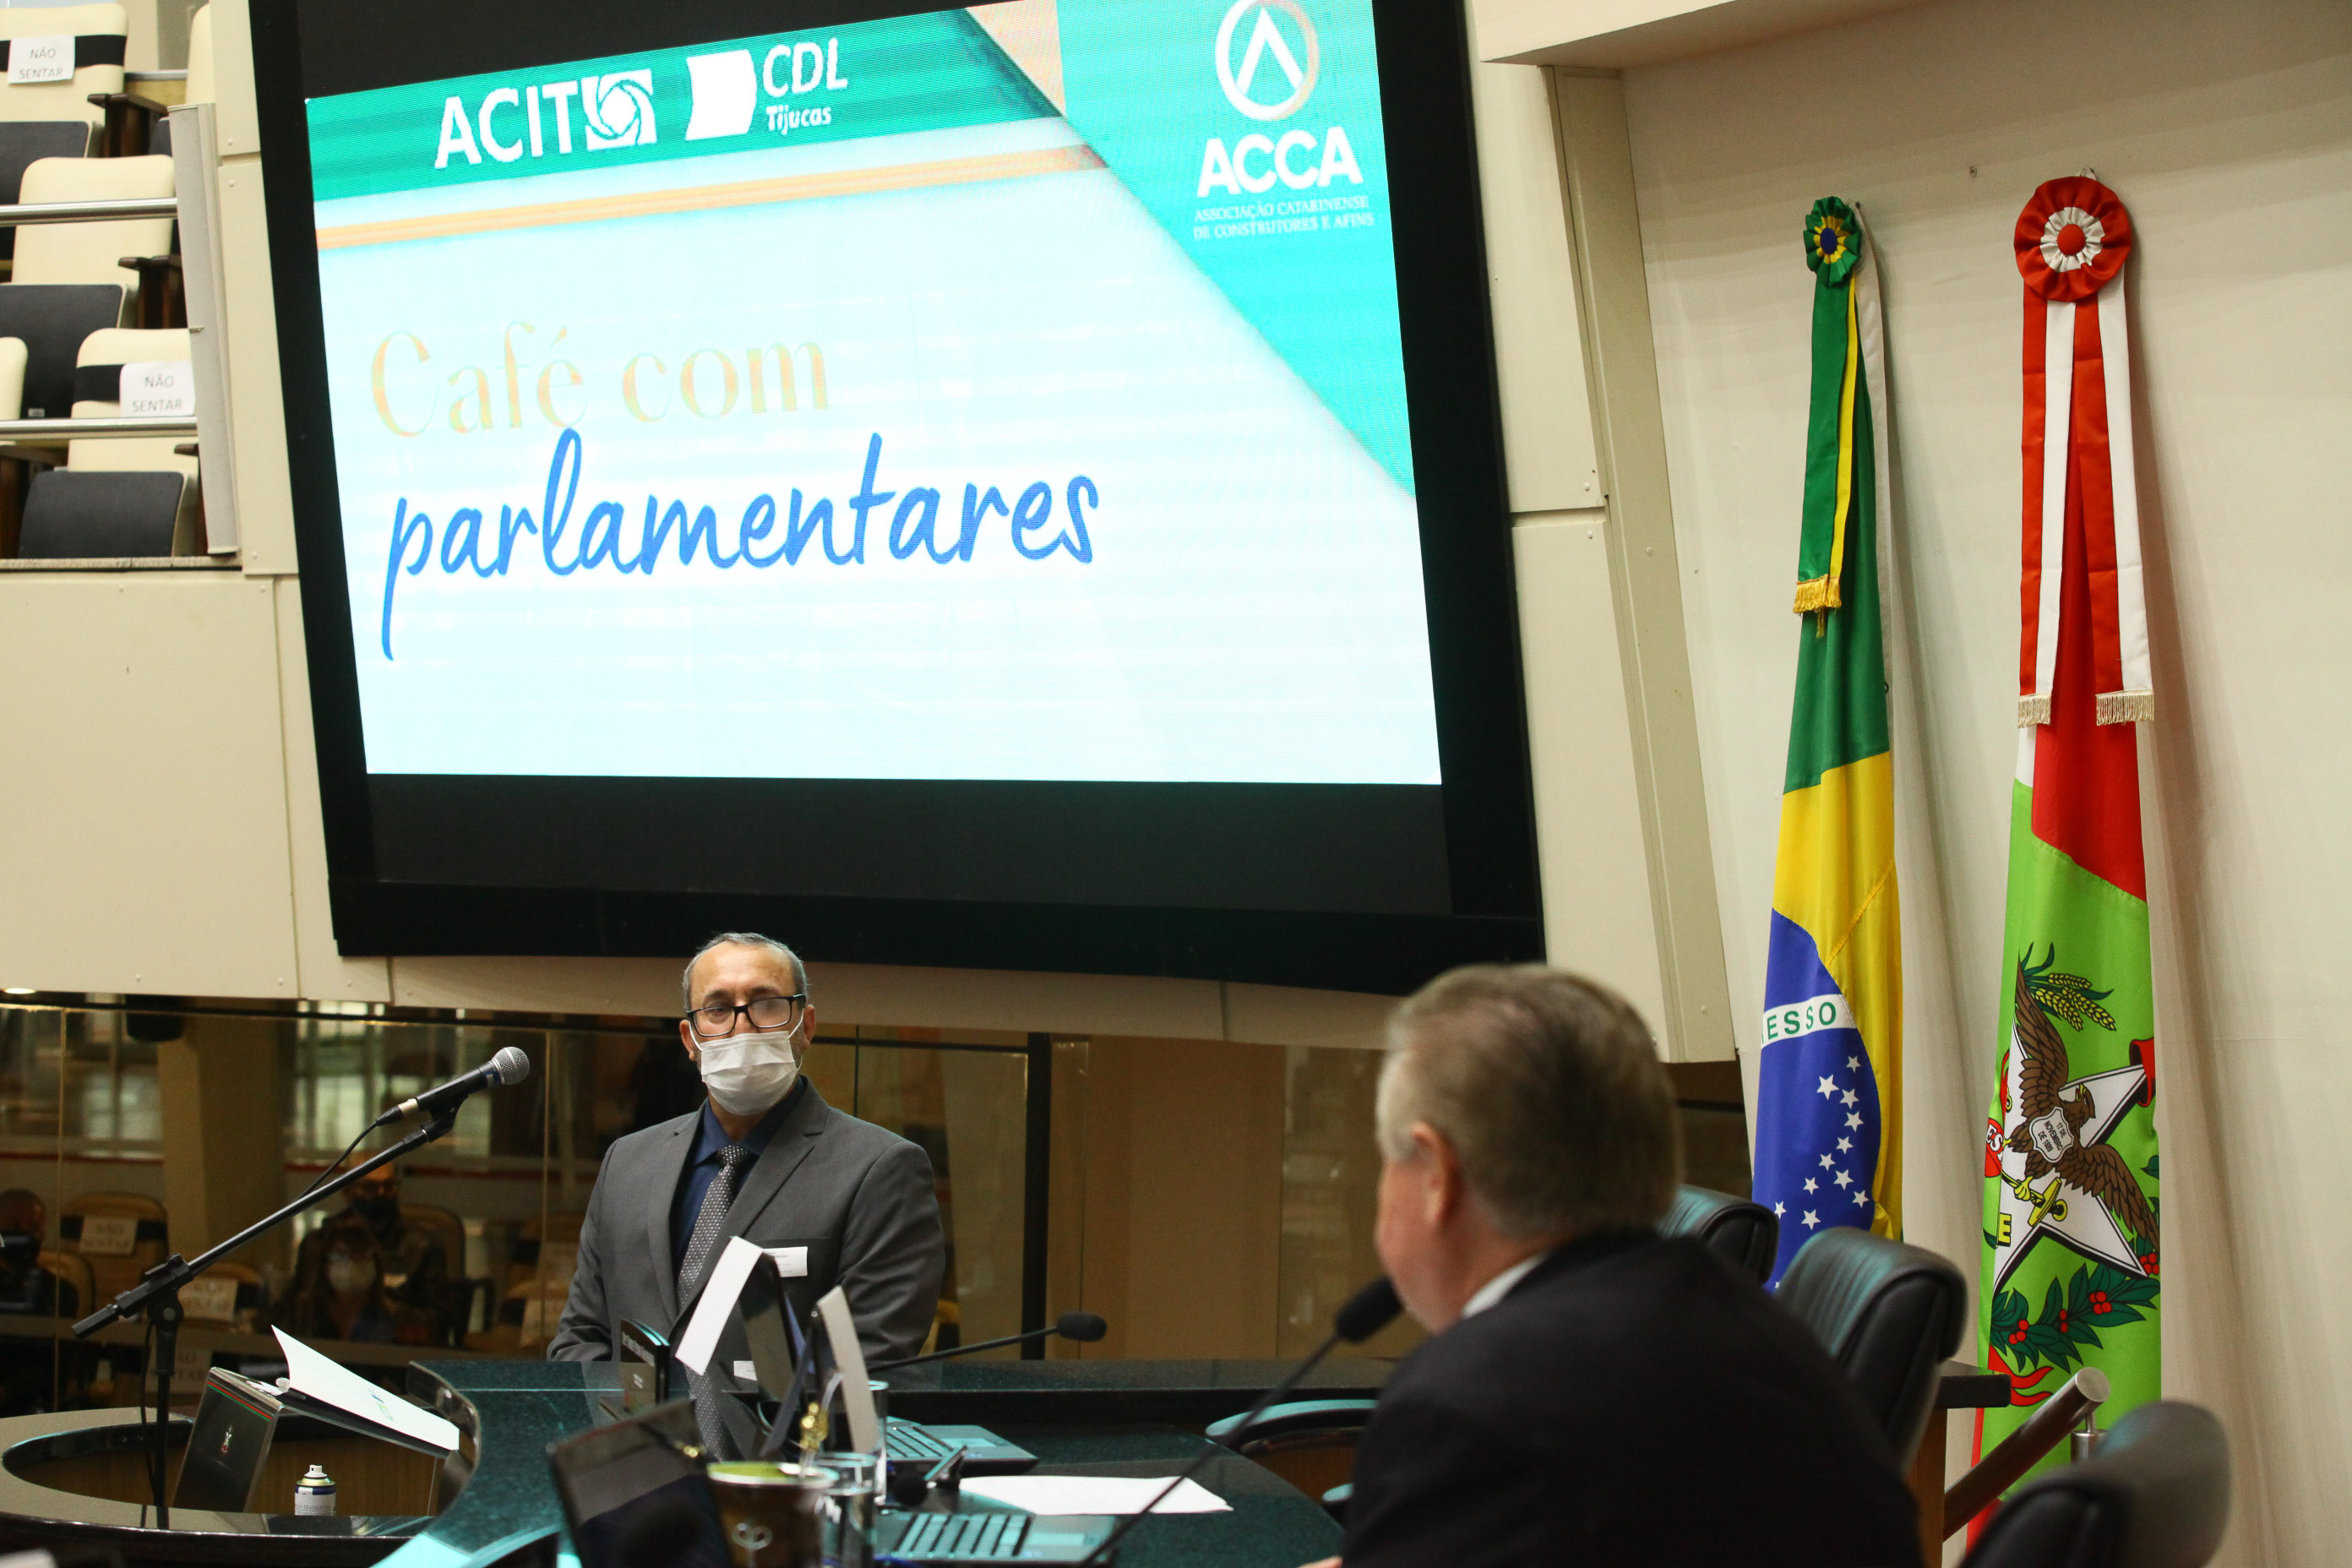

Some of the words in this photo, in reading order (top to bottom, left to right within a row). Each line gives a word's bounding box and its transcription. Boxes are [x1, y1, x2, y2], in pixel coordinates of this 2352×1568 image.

[30, 46, 57, 59] NÃO
[763, 37, 849, 98] CDL
[19, 68, 63, 79] SENTAR
[434, 79, 580, 170] ACIT
[765, 105, 832, 136] Tijucas
[1196, 125, 1364, 198] ACCA
[1194, 201, 1274, 223] ASSOCIAÇÃO
[1277, 194, 1369, 215] CATARINENSE
[144, 373, 175, 388] NÃO
[370, 319, 589, 438] Café
[621, 340, 829, 423] com
[132, 399, 182, 412] SENTAR
[381, 427, 1100, 662] parlamentares
[1761, 1001, 1837, 1044] ESSO
